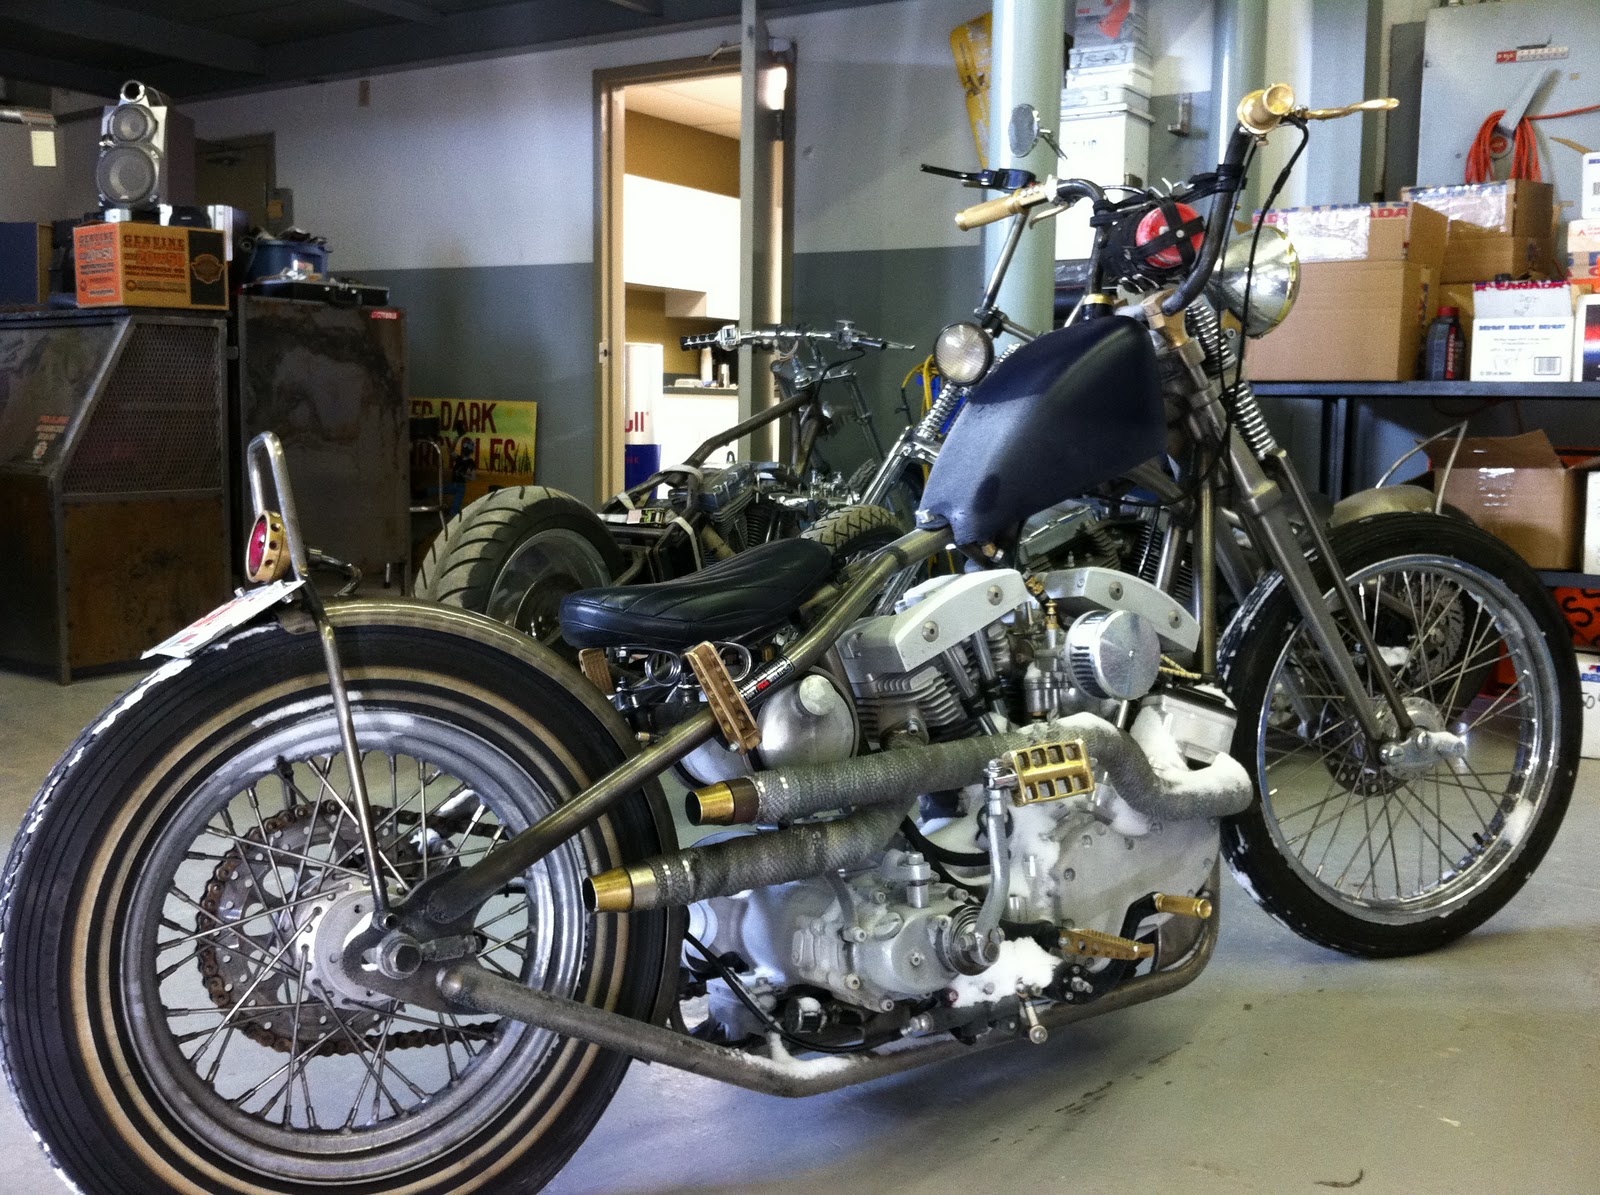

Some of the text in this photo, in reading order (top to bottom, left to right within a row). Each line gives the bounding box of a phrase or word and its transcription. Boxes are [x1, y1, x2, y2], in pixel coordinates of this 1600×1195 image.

[124, 235, 185, 246] GENUINE
[440, 401, 497, 433] DARK
[625, 411, 644, 433] ull
